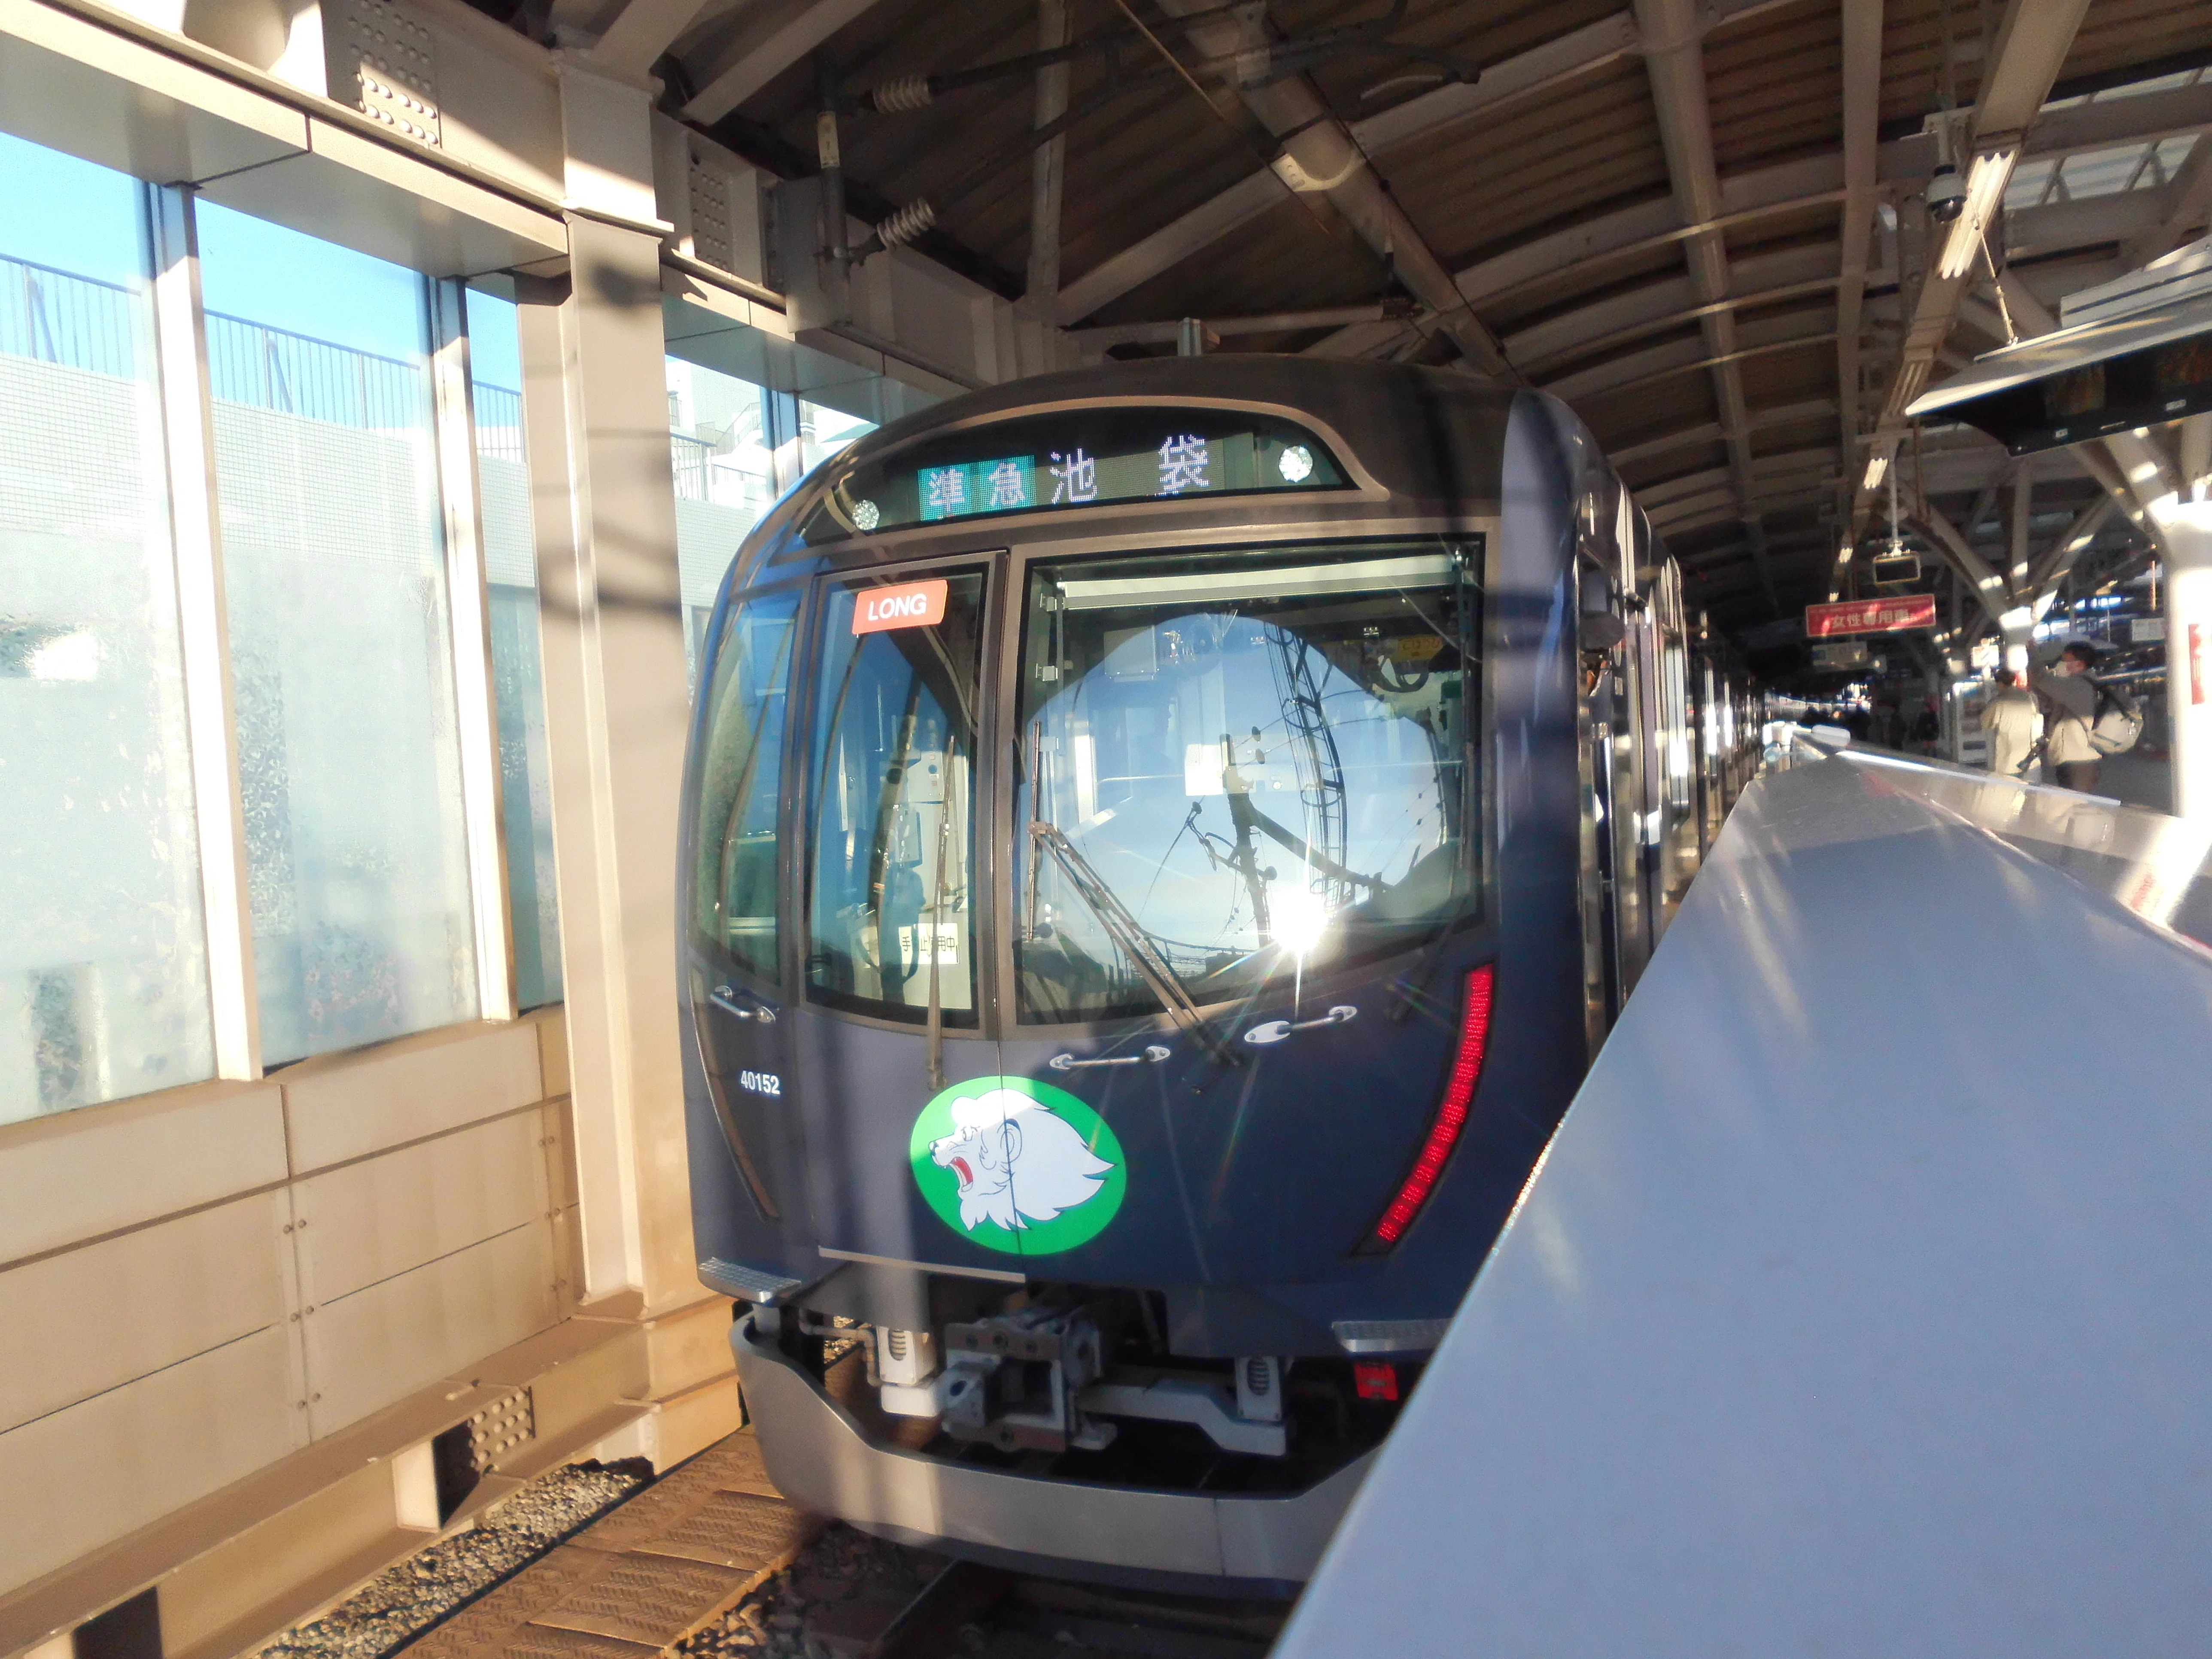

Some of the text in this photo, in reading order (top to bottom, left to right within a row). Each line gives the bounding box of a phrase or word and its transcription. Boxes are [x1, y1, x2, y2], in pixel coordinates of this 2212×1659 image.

[928, 434, 1210, 514] 準急 池袋
[868, 593, 927, 621] LONG
[902, 936, 955, 953] 手止用中
[741, 1070, 781, 1095] 40152
